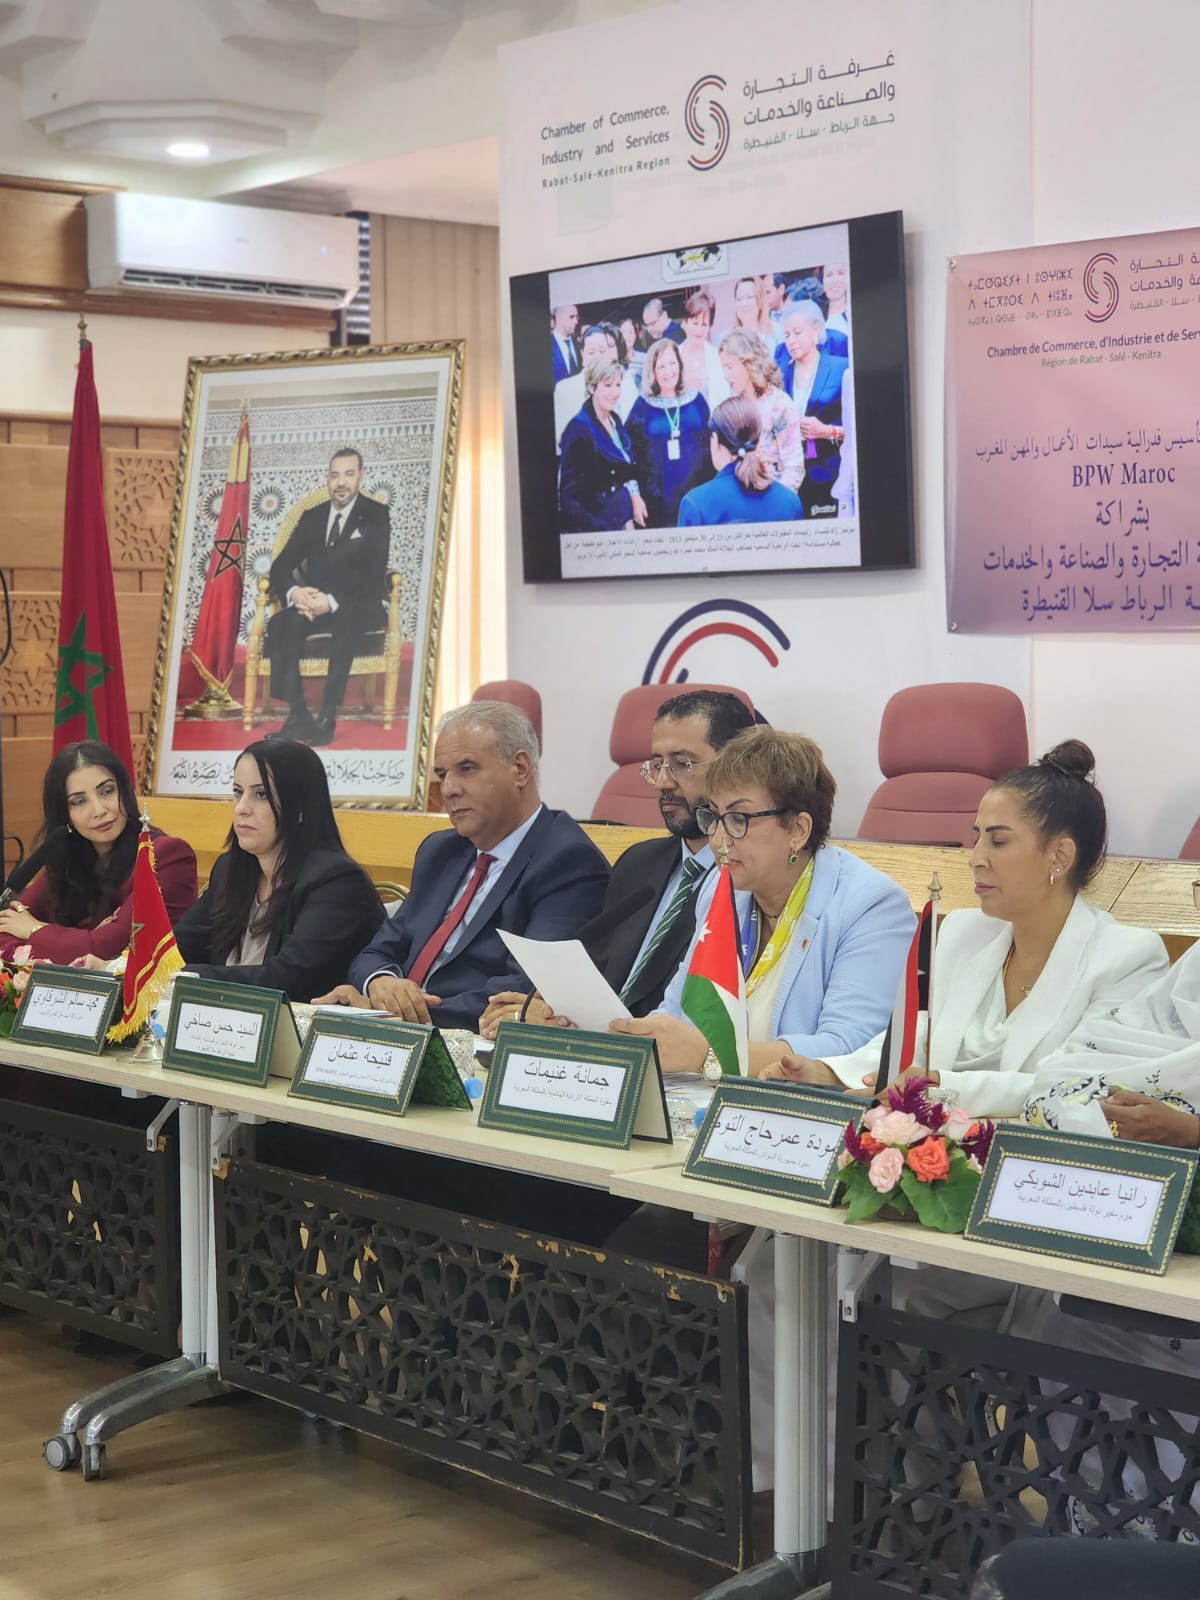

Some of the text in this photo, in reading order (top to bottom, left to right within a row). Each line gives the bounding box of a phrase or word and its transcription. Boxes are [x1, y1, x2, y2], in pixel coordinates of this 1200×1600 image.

[743, 67, 812, 99] التجارة
[743, 81, 895, 125] والصناعة والخدمات
[541, 103, 670, 141] Chamber of Commerce,
[795, 126, 819, 140] سلا
[830, 117, 860, 135] الرباط
[863, 113, 895, 127] جهة
[542, 129, 670, 167] Industry and Services
[743, 131, 786, 152] القنيطرة
[636, 155, 671, 173] Region
[1130, 253, 1183, 275] التجارة
[1130, 275, 1183, 293] والخدمات
[987, 341, 1028, 358] Chambre
[1029, 342, 1041, 355] de
[1042, 338, 1098, 354] Commerce,
[1100, 333, 1152, 349] d'Industrie
[1154, 332, 1165, 344] et
[1167, 330, 1180, 342] de
[1041, 356, 1067, 369] Région
[1068, 356, 1078, 366] de
[1079, 353, 1103, 365] Rabat
[1109, 350, 1126, 362] Salé
[1132, 349, 1162, 361] Kenitra
[1086, 432, 1124, 454] سيدات
[1072, 462, 1176, 487] BPW Maroc
[1096, 499, 1150, 536] بشراكة
[983, 543, 1053, 580] والخدمات
[1059, 541, 1125, 578] والصناعة
[1132, 540, 1188, 578] التجارة
[1022, 584, 1076, 622] القنيطرة
[1083, 585, 1114, 612] سلا
[1121, 584, 1173, 622] الرباط
[237, 1021, 258, 1038] السيد
[328, 1042, 393, 1069] فتيحة عثمان
[524, 1060, 610, 1090] جمانة غنيمات
[1014, 1168, 1148, 1208] رانيا عابدين الشوبكي
